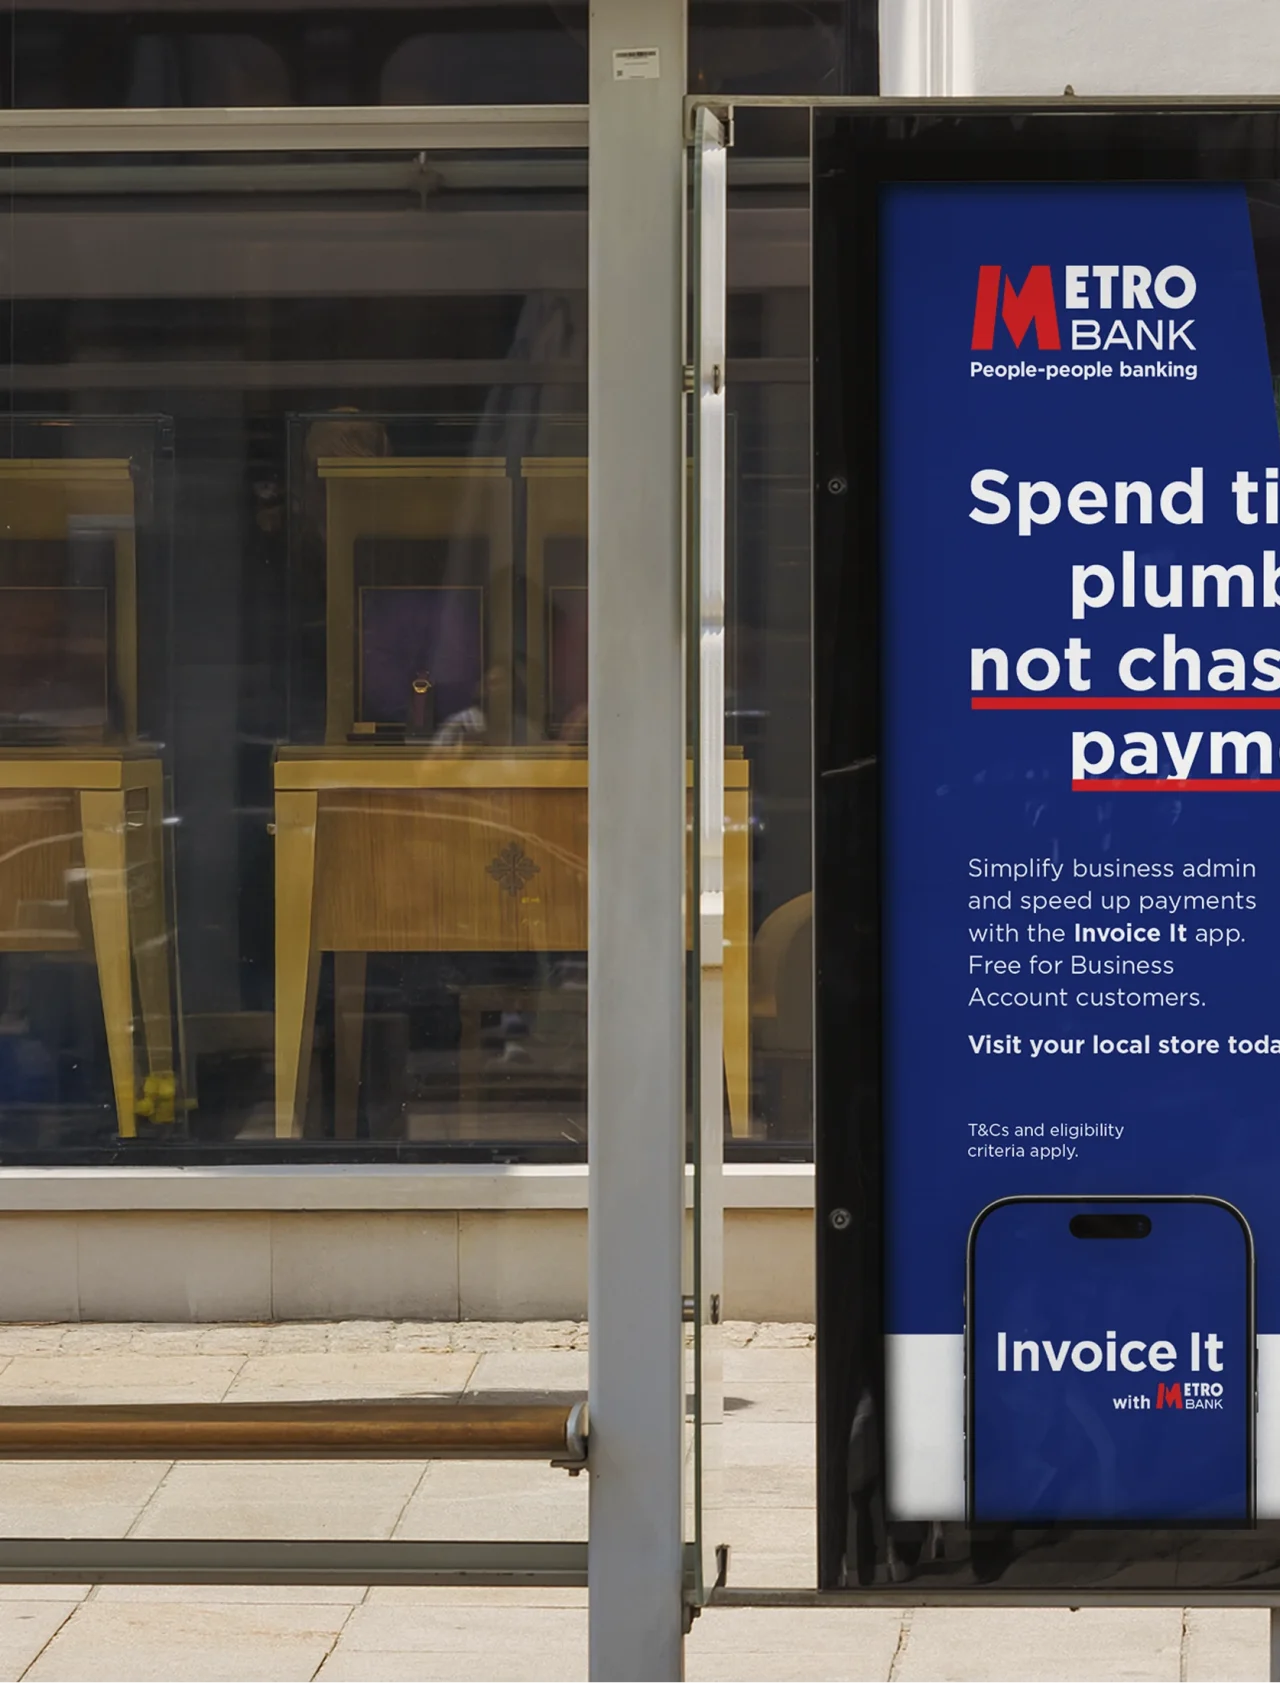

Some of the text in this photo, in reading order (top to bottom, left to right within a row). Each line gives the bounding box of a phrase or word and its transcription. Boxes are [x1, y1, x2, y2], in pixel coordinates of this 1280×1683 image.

[972, 265, 1196, 350] METRO
[1072, 320, 1196, 350] BANK
[971, 361, 1197, 380] People-people banking
[969, 467, 1203, 536] Spend
[971, 638, 1090, 691] not
[969, 858, 1255, 881] Simplify business admin
[969, 891, 1256, 913] and speed up payments
[969, 923, 1244, 946] with the Invoice It app.
[970, 955, 1173, 974] Free for Business
[969, 988, 1205, 1006] Account customers.
[969, 1035, 1021, 1053] Visit
[1030, 1040, 1085, 1057] your
[1094, 1035, 1149, 1053] local
[1159, 1036, 1219, 1053] store
[968, 1123, 1124, 1139] T&Cs and eligibility
[968, 1144, 1078, 1160] criteria apply.
[998, 1331, 1223, 1372] Invoice It
[1113, 1395, 1150, 1409] with
[1156, 1383, 1223, 1409] METRO
[1186, 1399, 1222, 1409] BANK
